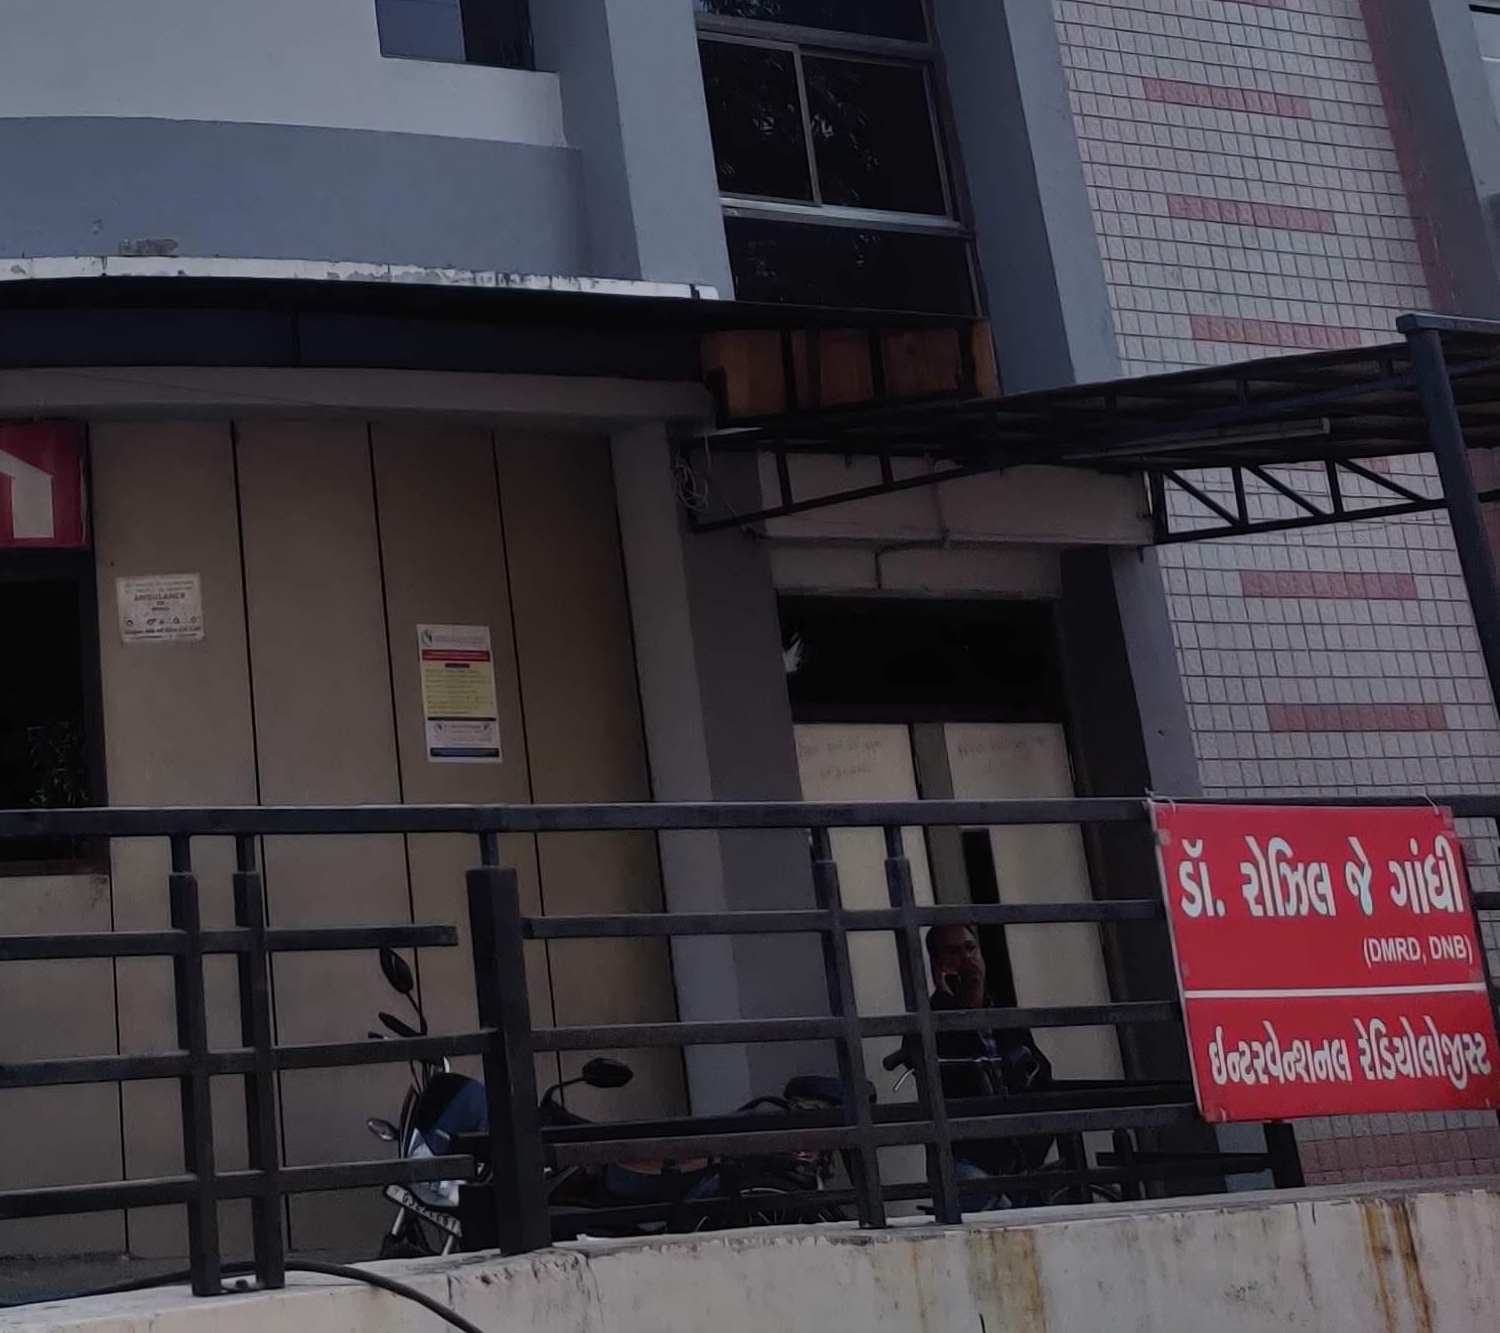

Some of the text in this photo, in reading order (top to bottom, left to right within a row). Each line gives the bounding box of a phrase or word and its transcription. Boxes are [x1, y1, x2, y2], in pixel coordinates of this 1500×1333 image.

[1179, 838, 1226, 918] ડૉ.
[1345, 835, 1374, 916] જે
[1387, 834, 1465, 915] ગાંધી
[1363, 933, 1473, 970] (DMRD, DNB)
